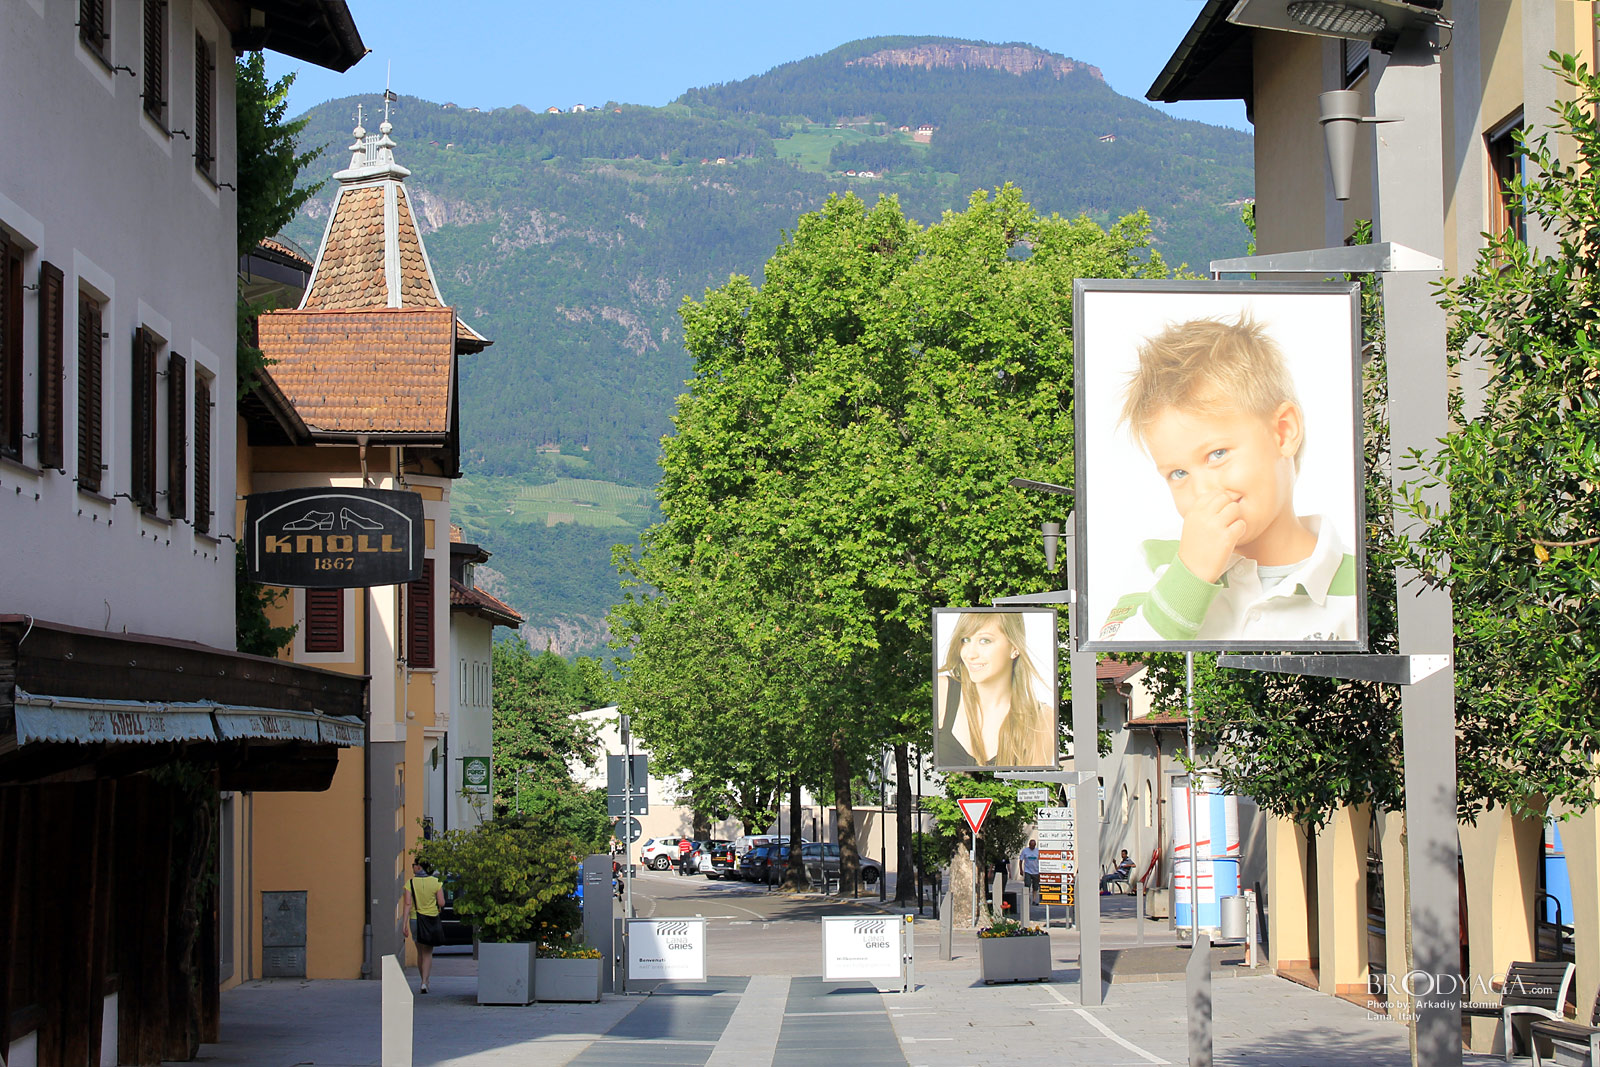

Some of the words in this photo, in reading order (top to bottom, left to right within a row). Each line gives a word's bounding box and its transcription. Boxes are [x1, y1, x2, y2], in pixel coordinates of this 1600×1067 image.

[265, 534, 403, 553] KNOLL
[314, 557, 355, 571] 1867
[110, 712, 145, 736] KNOLL
